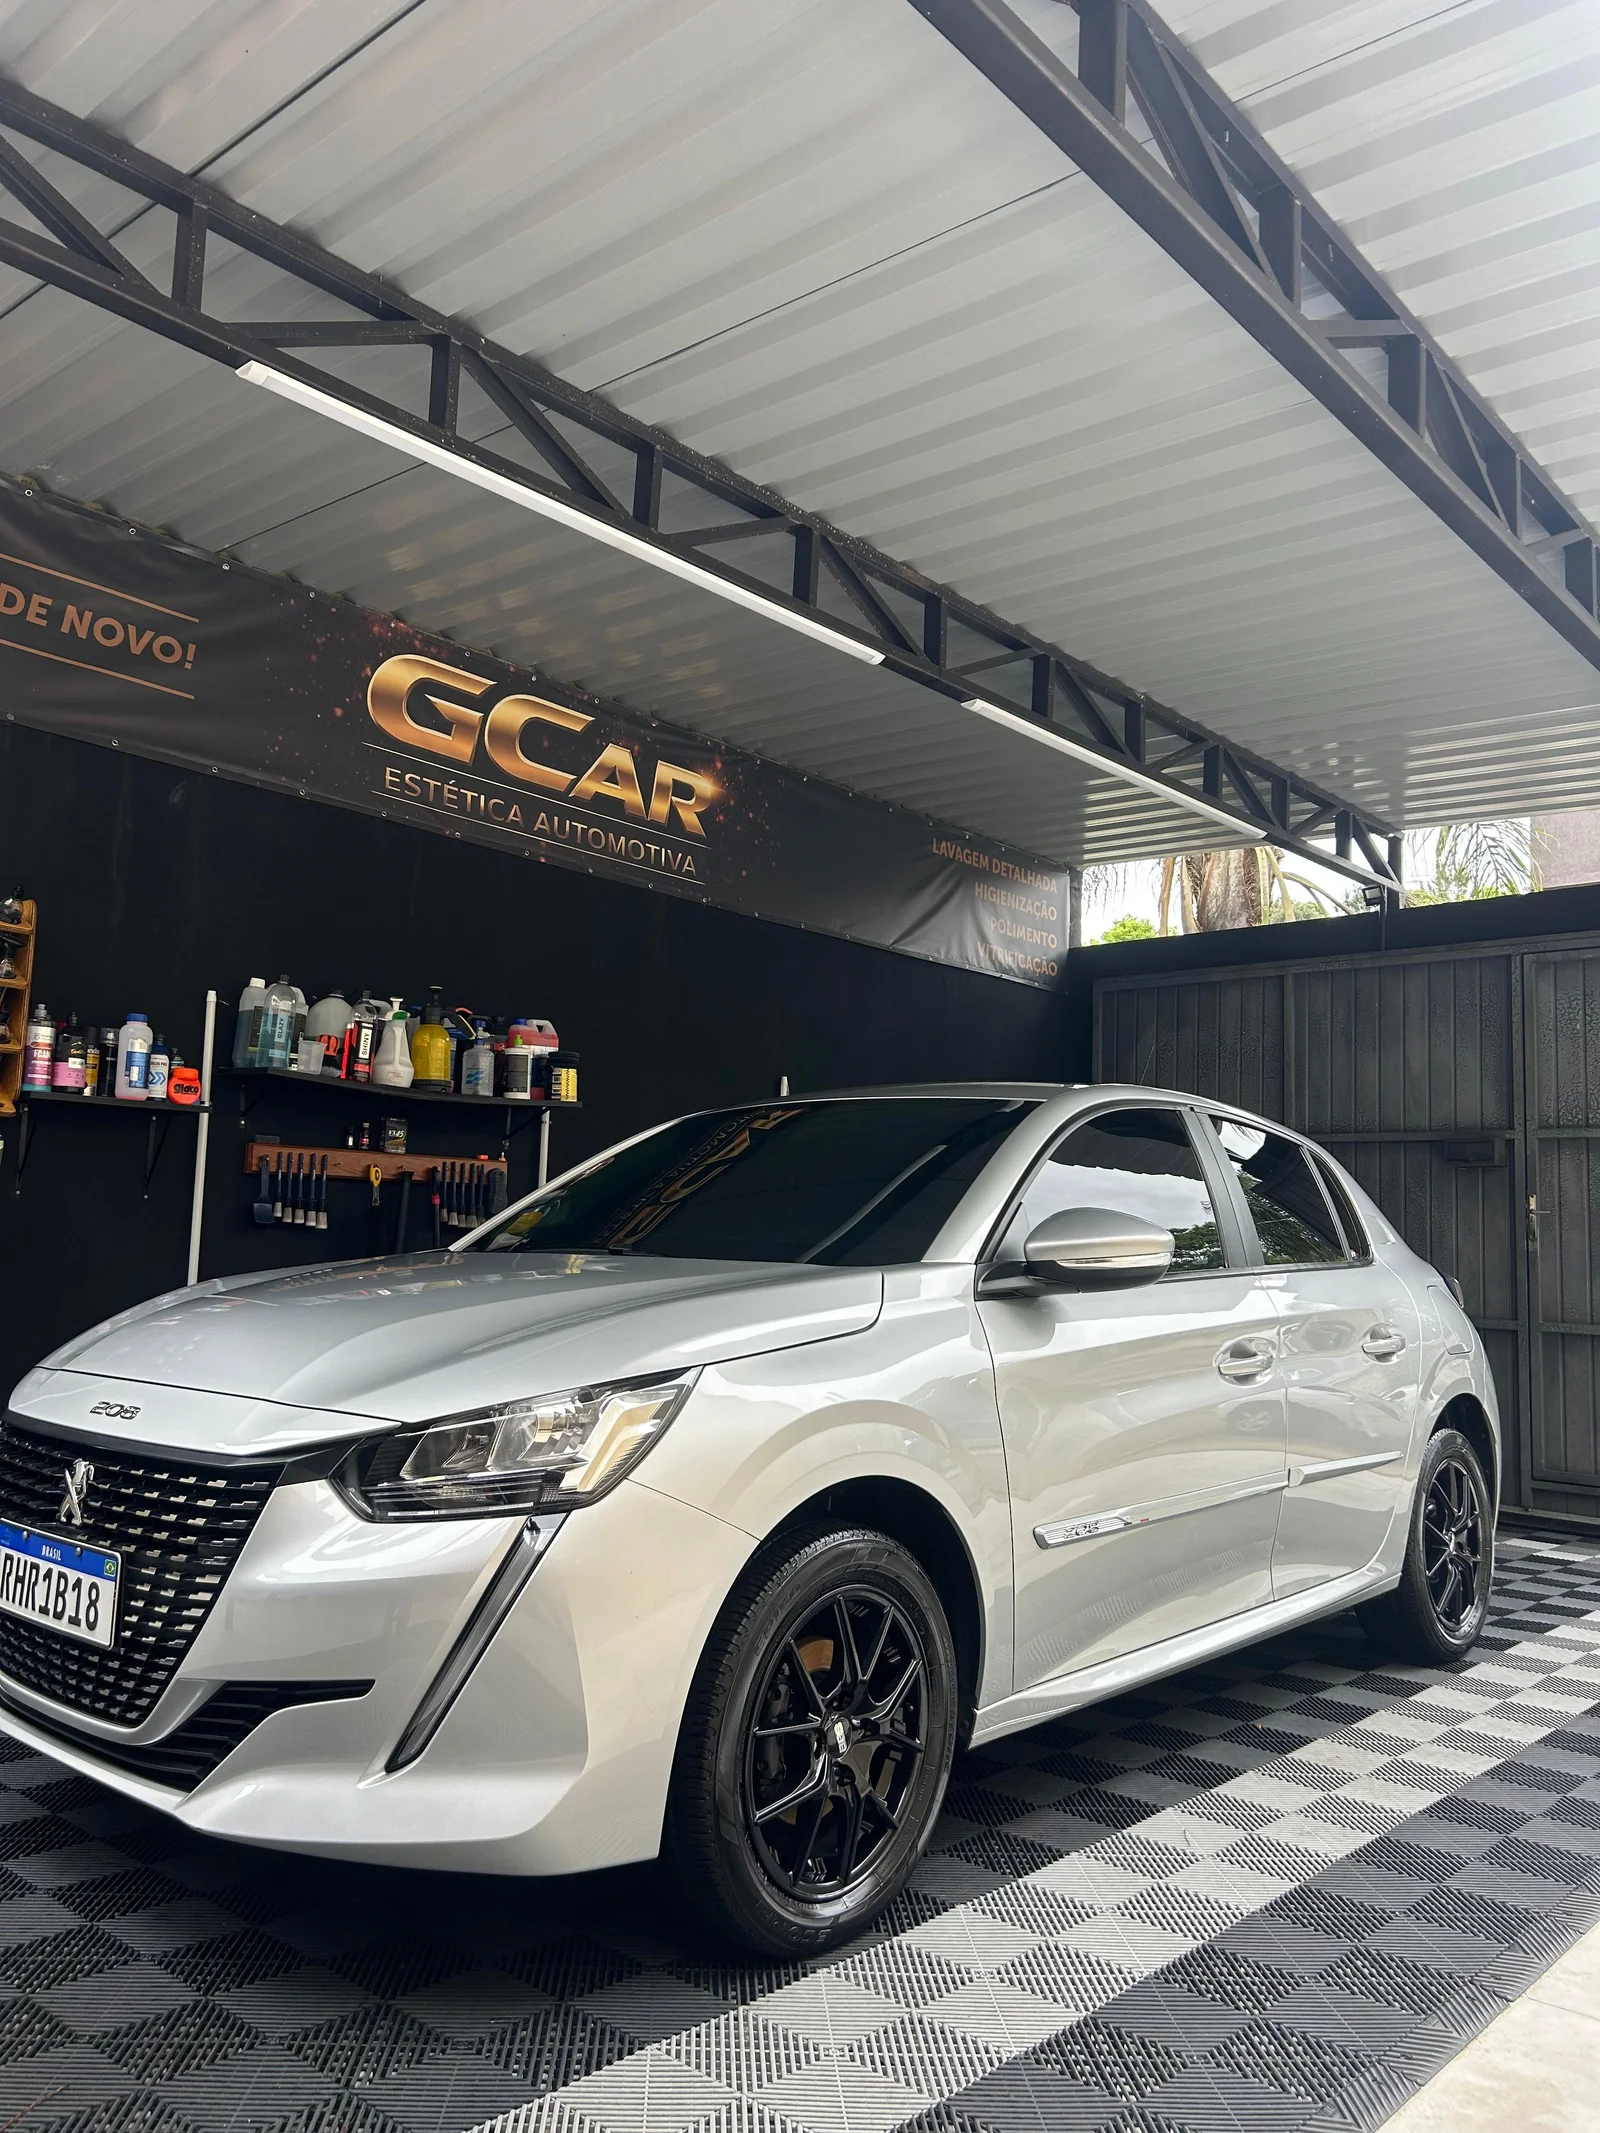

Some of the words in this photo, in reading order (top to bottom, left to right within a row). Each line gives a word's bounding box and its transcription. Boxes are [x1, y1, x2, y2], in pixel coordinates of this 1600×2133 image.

[0, 582, 53, 627] DE
[60, 604, 197, 670] NOVO!
[365, 653, 714, 838] GCAR
[384, 766, 525, 828] ESTÉTICA
[533, 811, 698, 876] AUTOMOTIVA
[932, 838, 989, 871] LAVAGEM
[992, 858, 1058, 894] DETALHADA
[975, 881, 1058, 921] HIGIENIZAÇÃO
[990, 916, 1058, 949] POLIMENTO
[977, 941, 1058, 977] VITRIFICAÇÃO
[277, 1018, 285, 1039] GLAZY
[362, 1033, 370, 1055] SHINY
[89, 1401, 141, 1420] 208
[41, 1544, 62, 1561] BRASIL
[0, 1552, 101, 1631] RHR1B18
